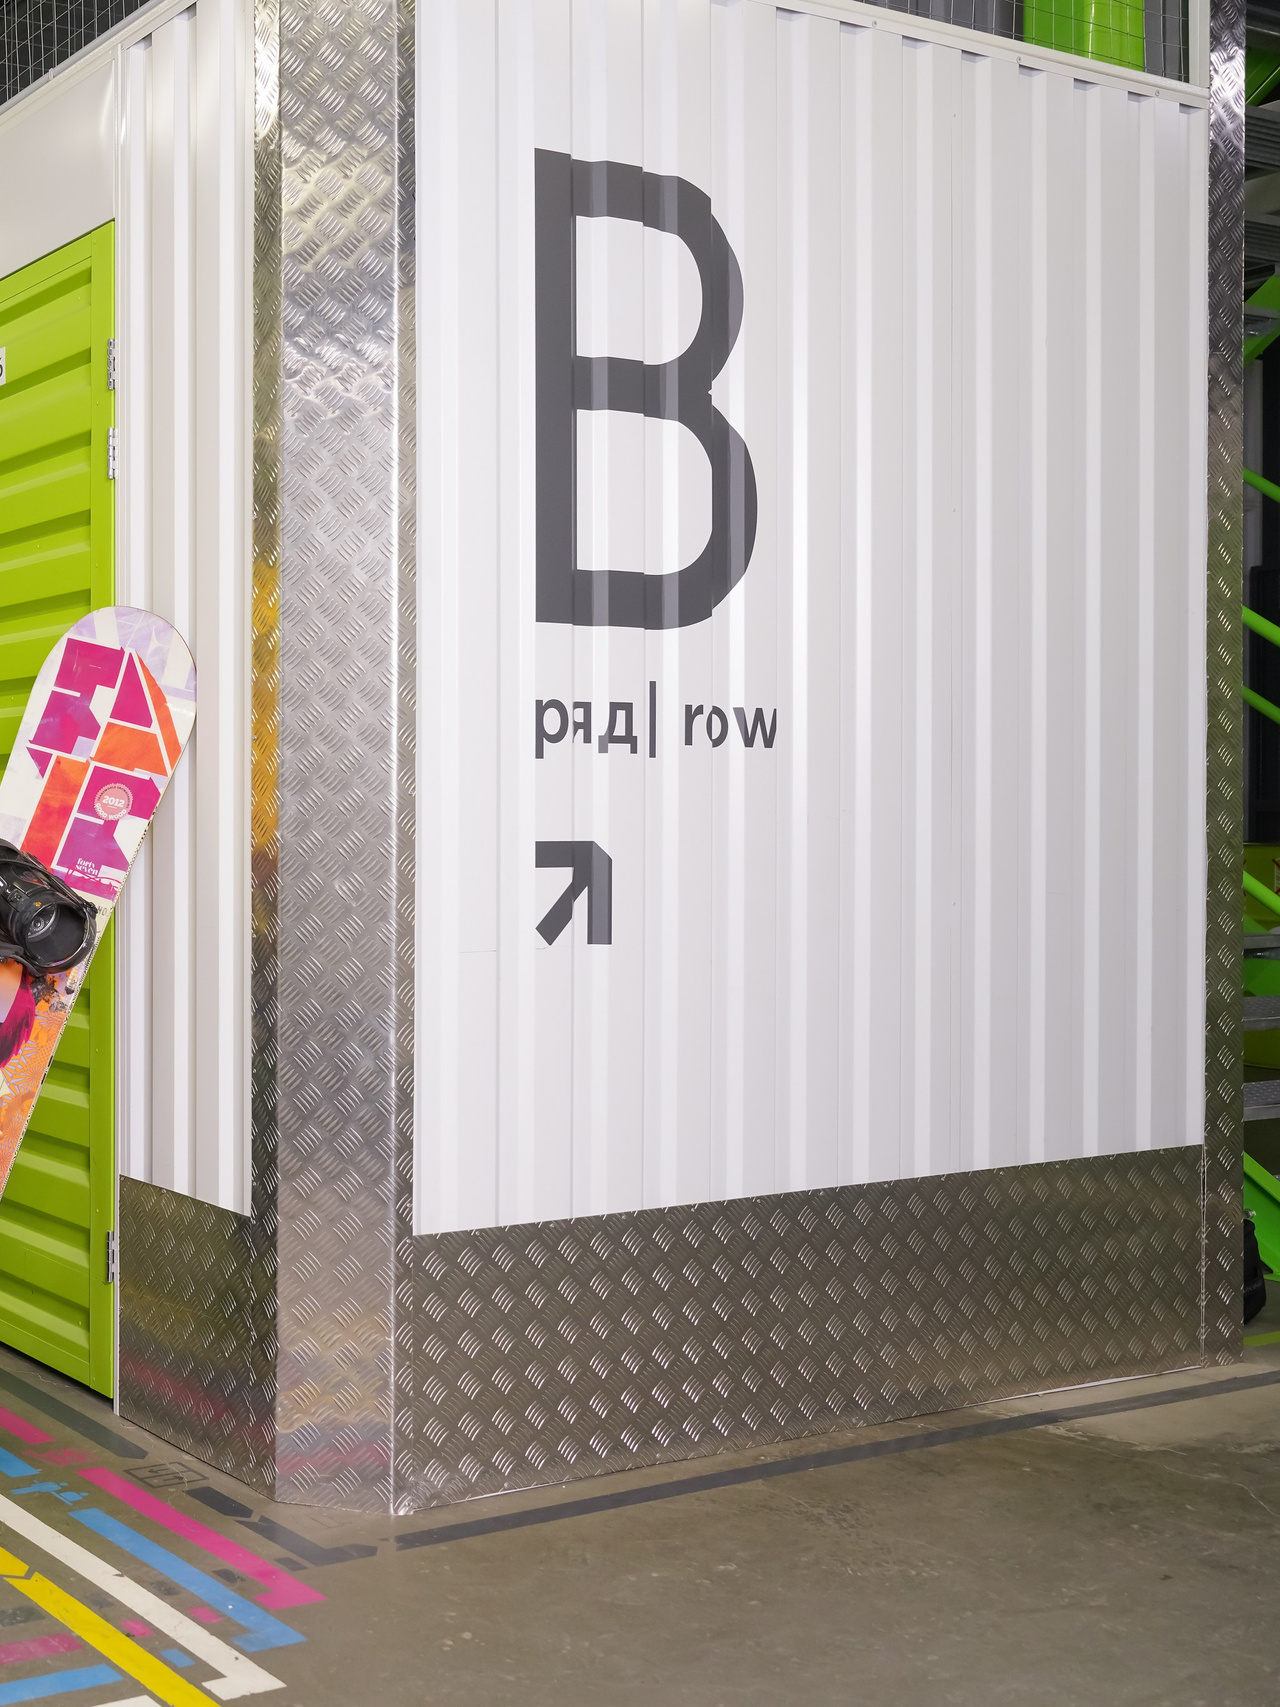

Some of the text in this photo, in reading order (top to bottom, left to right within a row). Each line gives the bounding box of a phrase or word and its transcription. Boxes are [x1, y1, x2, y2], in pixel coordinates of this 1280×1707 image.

[534, 148, 759, 630] B
[684, 701, 778, 749] row
[94, 802, 127, 821] GOOD WOOD
[102, 795, 125, 807] 2012
